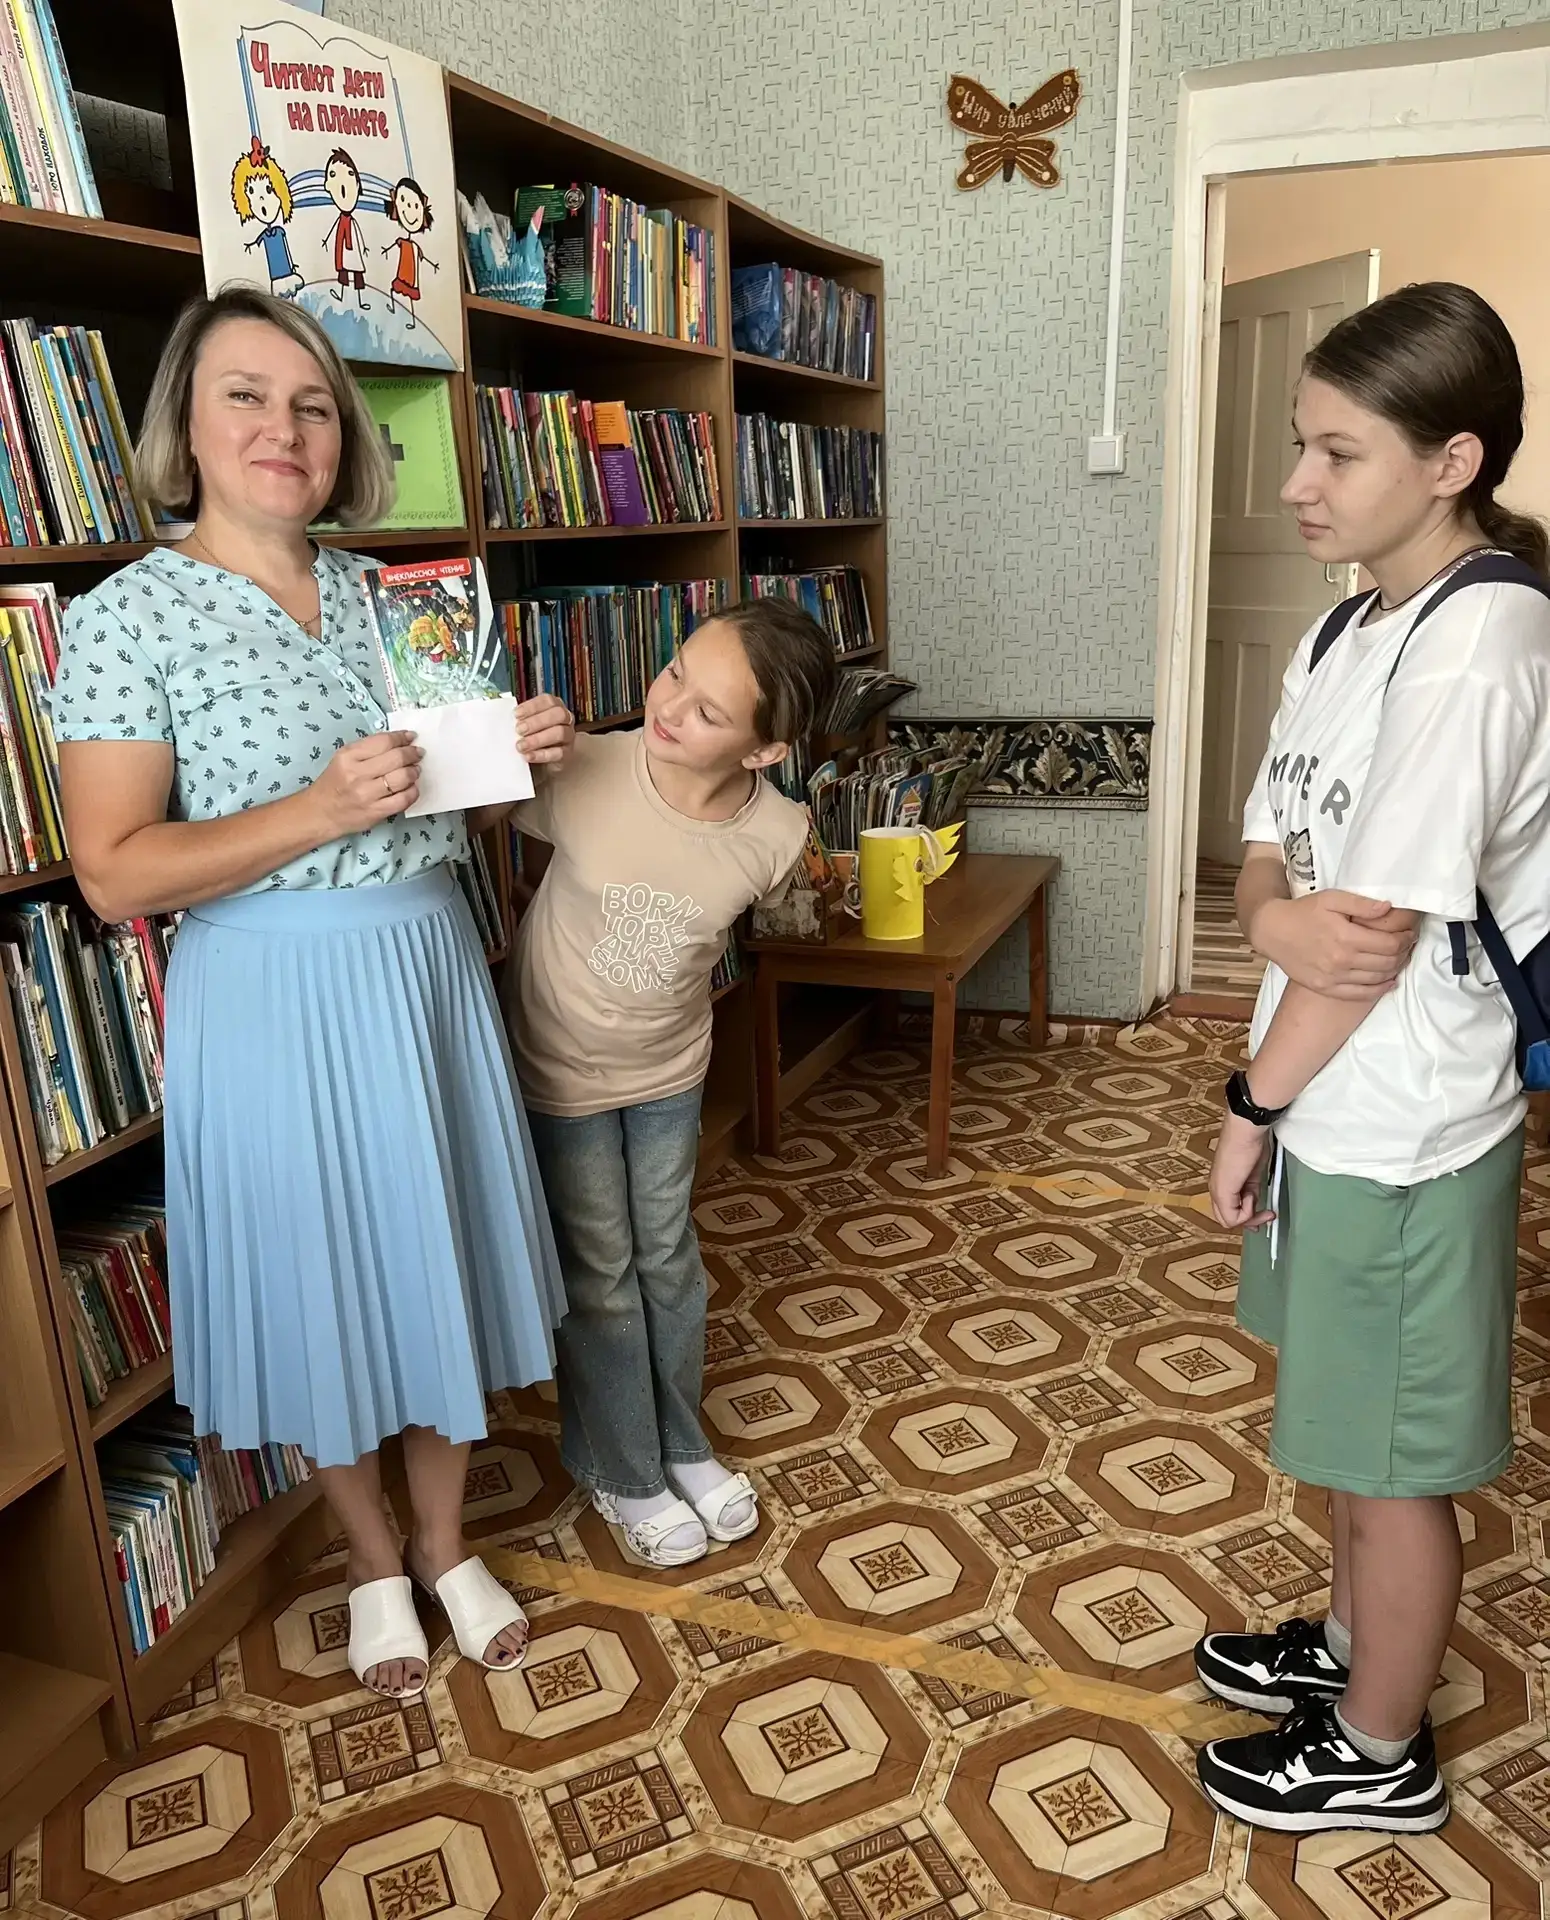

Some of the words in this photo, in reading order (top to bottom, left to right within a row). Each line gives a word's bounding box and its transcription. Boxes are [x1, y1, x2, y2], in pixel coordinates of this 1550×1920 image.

[250, 40, 334, 93] Читают
[343, 66, 385, 99] дети
[286, 101, 315, 132] на
[317, 103, 389, 139] планете
[961, 90, 991, 128] Мир
[385, 568, 438, 583] ВНЕКЛАССНОЕ
[439, 563, 466, 575] ЧТЕНИЕ
[602, 882, 704, 925] BORN
